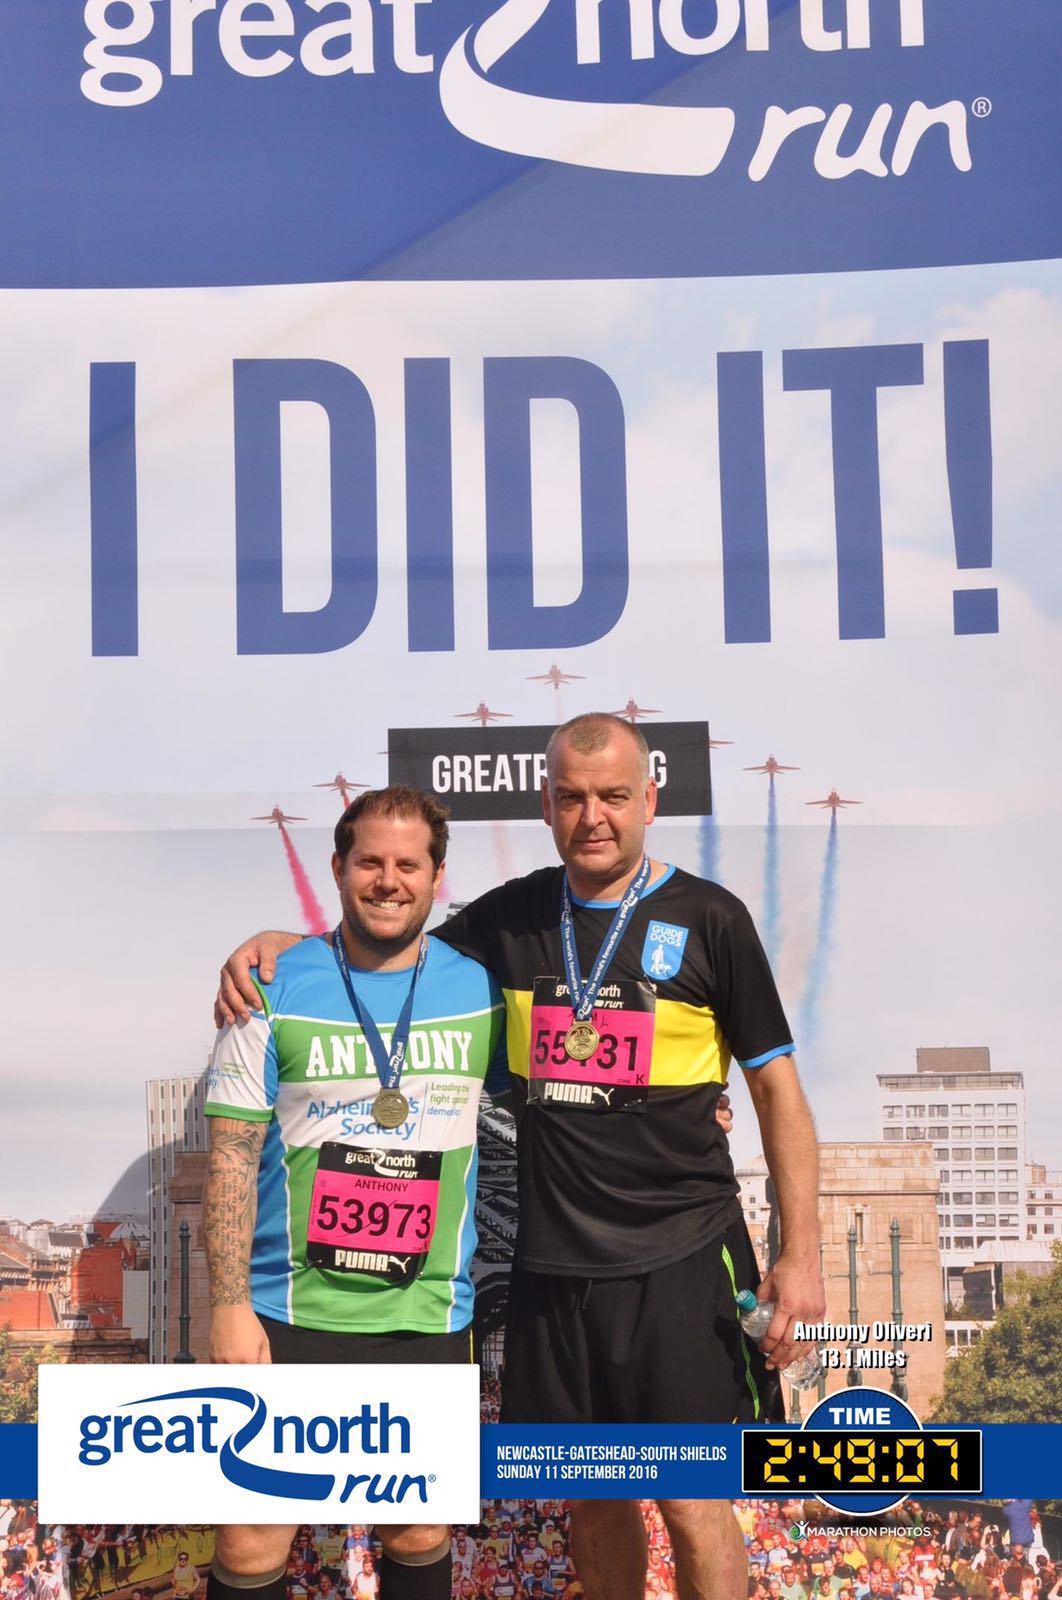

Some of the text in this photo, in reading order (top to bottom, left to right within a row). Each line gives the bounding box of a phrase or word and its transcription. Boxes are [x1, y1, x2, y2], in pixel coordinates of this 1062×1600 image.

[89, 339, 1000, 657] I DID IT!
[650, 933, 681, 947] DOGS
[652, 925, 685, 939] GUIDE
[597, 985, 621, 997] orth
[306, 1030, 472, 1077] ANTONY
[535, 1030, 638, 1071] 5531
[636, 1074, 645, 1084] K
[430, 1093, 450, 1105] fight
[544, 1082, 593, 1104] PUMA
[307, 1097, 420, 1119] Alzhei's
[345, 1151, 416, 1168] great north
[399, 1170, 419, 1179] run
[355, 1179, 408, 1192] ANTHONY
[317, 1195, 431, 1239] 53973
[335, 1249, 389, 1272] PUMA
